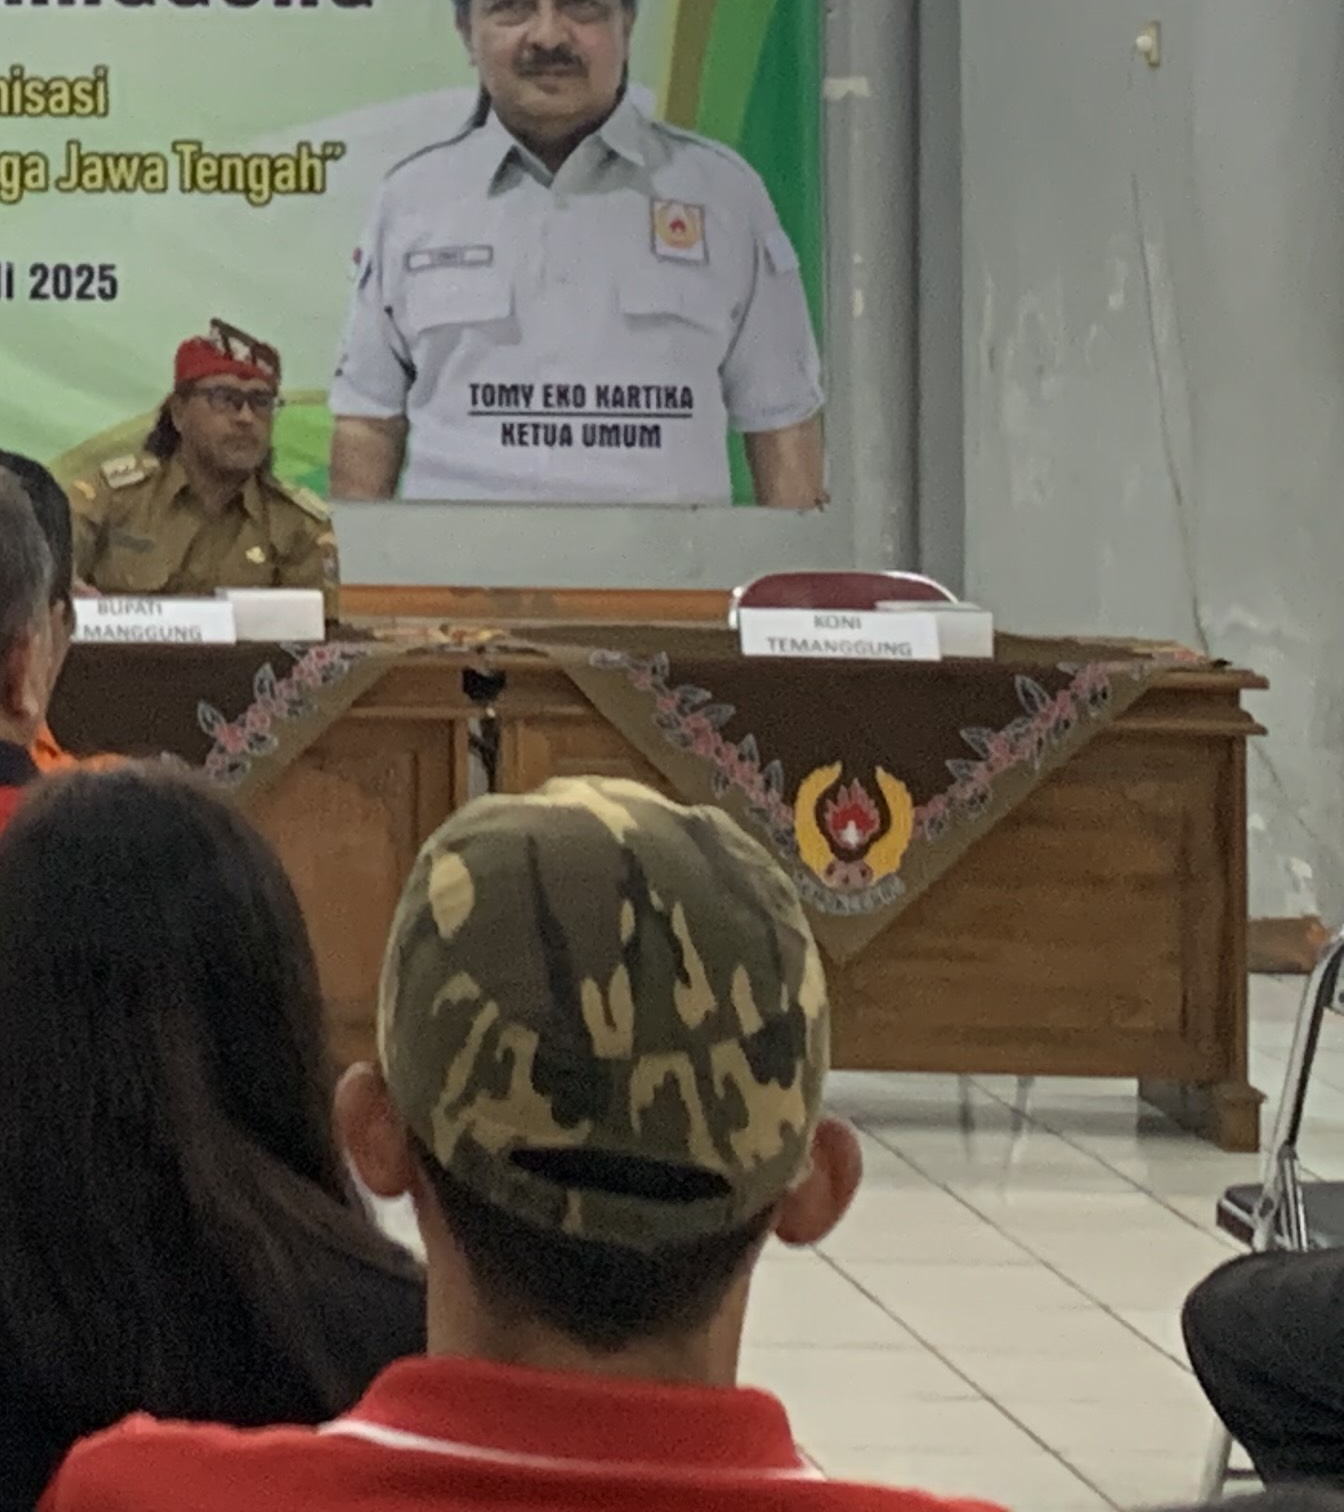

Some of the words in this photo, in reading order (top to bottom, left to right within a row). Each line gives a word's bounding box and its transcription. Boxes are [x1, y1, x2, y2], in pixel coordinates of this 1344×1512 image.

[58, 139, 168, 193] Jawa
[29, 263, 119, 301] 2025
[469, 383, 534, 408] TOMY
[542, 383, 587, 408] EKO
[596, 384, 694, 410] KARTIKA
[501, 422, 574, 447] KETUA
[582, 423, 662, 448] UMUM
[97, 598, 163, 616] BUPATI
[83, 624, 202, 641] MANGGUNG
[813, 614, 862, 630] KONI
[767, 637, 913, 656] TEMANGGUNG
